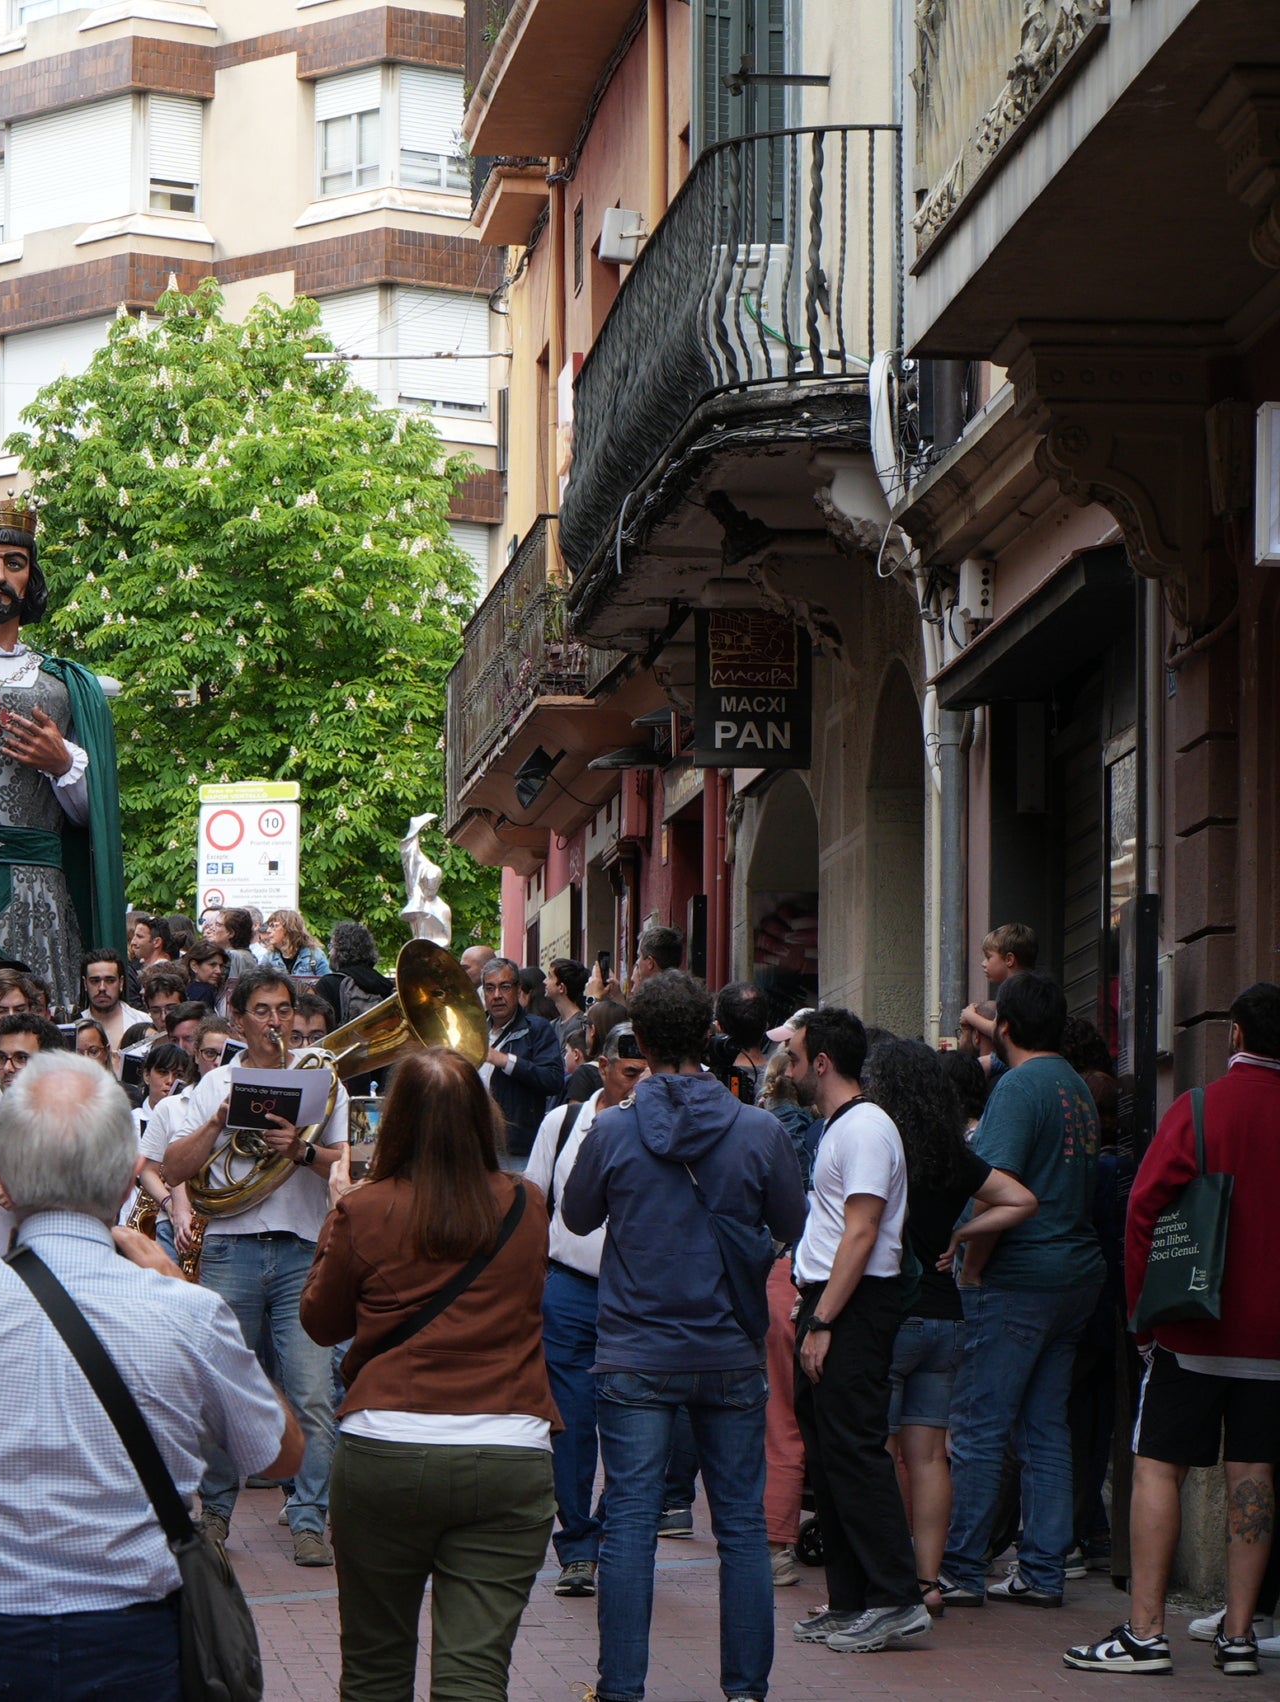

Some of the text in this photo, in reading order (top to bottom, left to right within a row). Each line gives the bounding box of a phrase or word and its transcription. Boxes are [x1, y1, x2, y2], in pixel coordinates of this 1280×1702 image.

[721, 696, 786, 713] MACXI
[714, 720, 791, 749] PAN
[265, 817, 280, 829] 10
[234, 1085, 258, 1094] banda
[269, 1089, 300, 1097] terrassa
[1151, 1249, 1170, 1262] Soci
